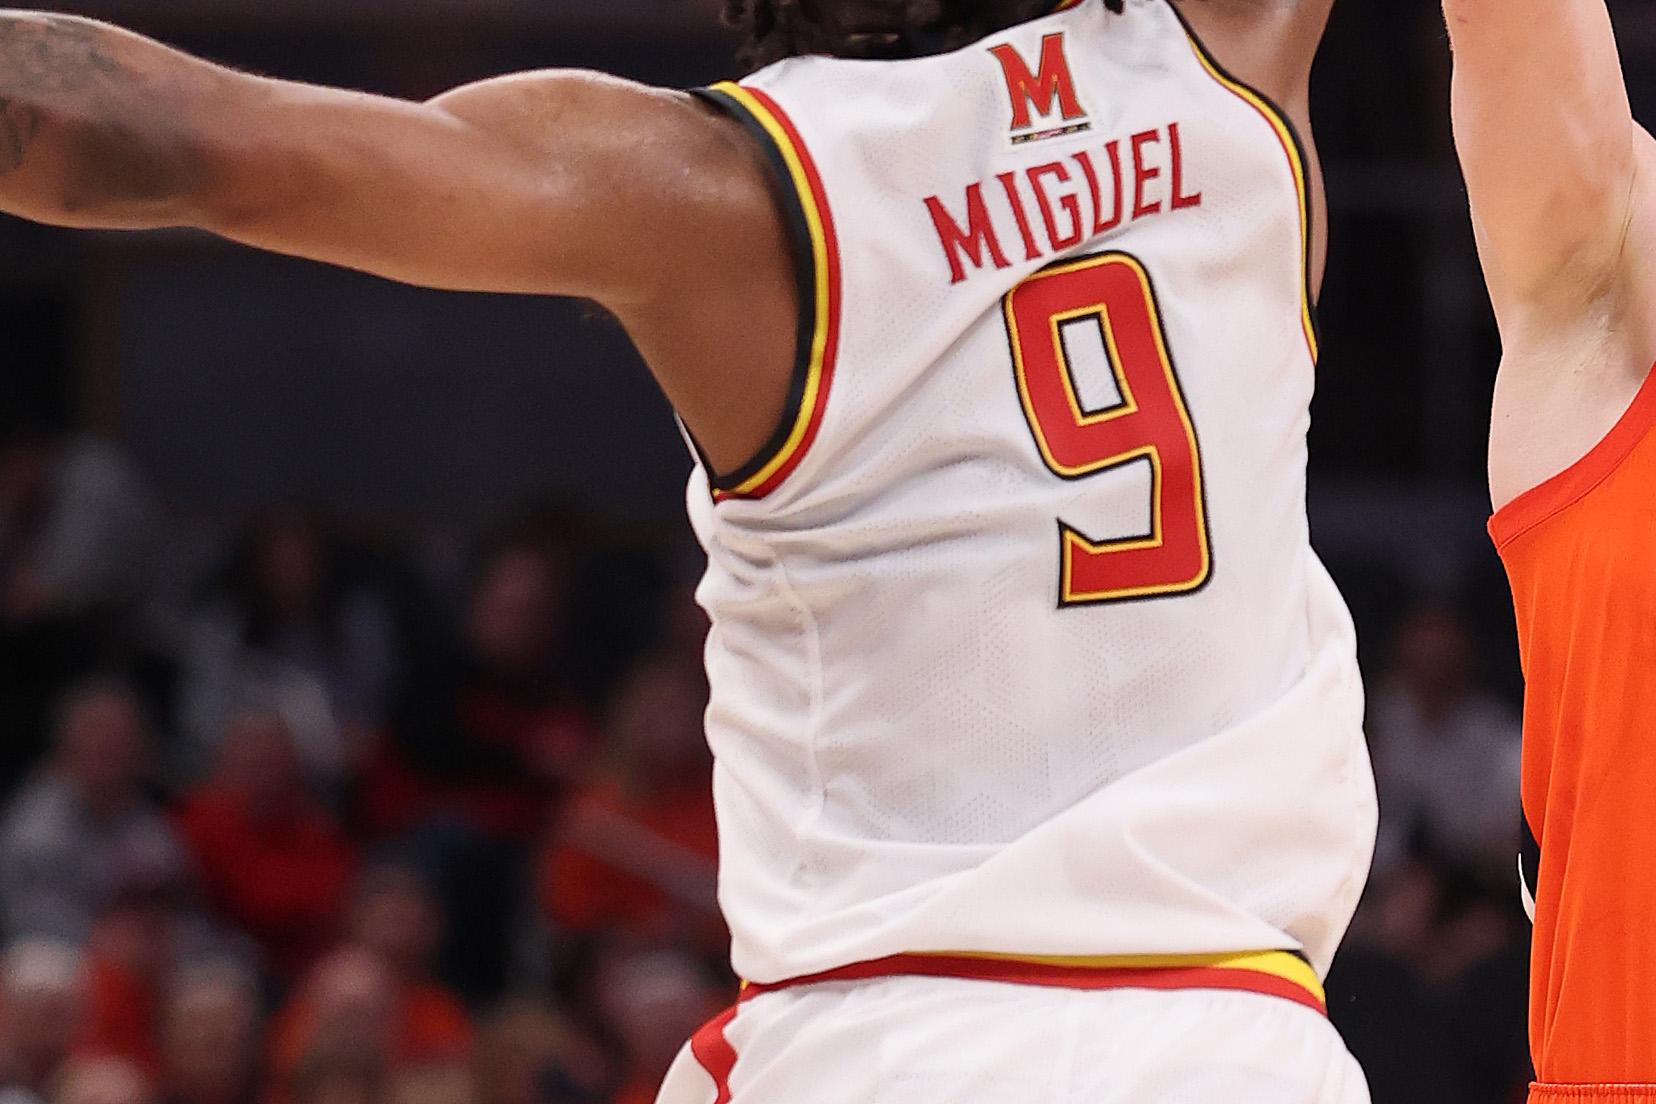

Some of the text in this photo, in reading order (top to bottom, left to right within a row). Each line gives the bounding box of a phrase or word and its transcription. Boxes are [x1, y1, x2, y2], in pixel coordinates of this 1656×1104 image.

[987, 32, 1088, 131] M
[922, 121, 1202, 285] MIGUEL
[1001, 248, 1213, 609] 9
